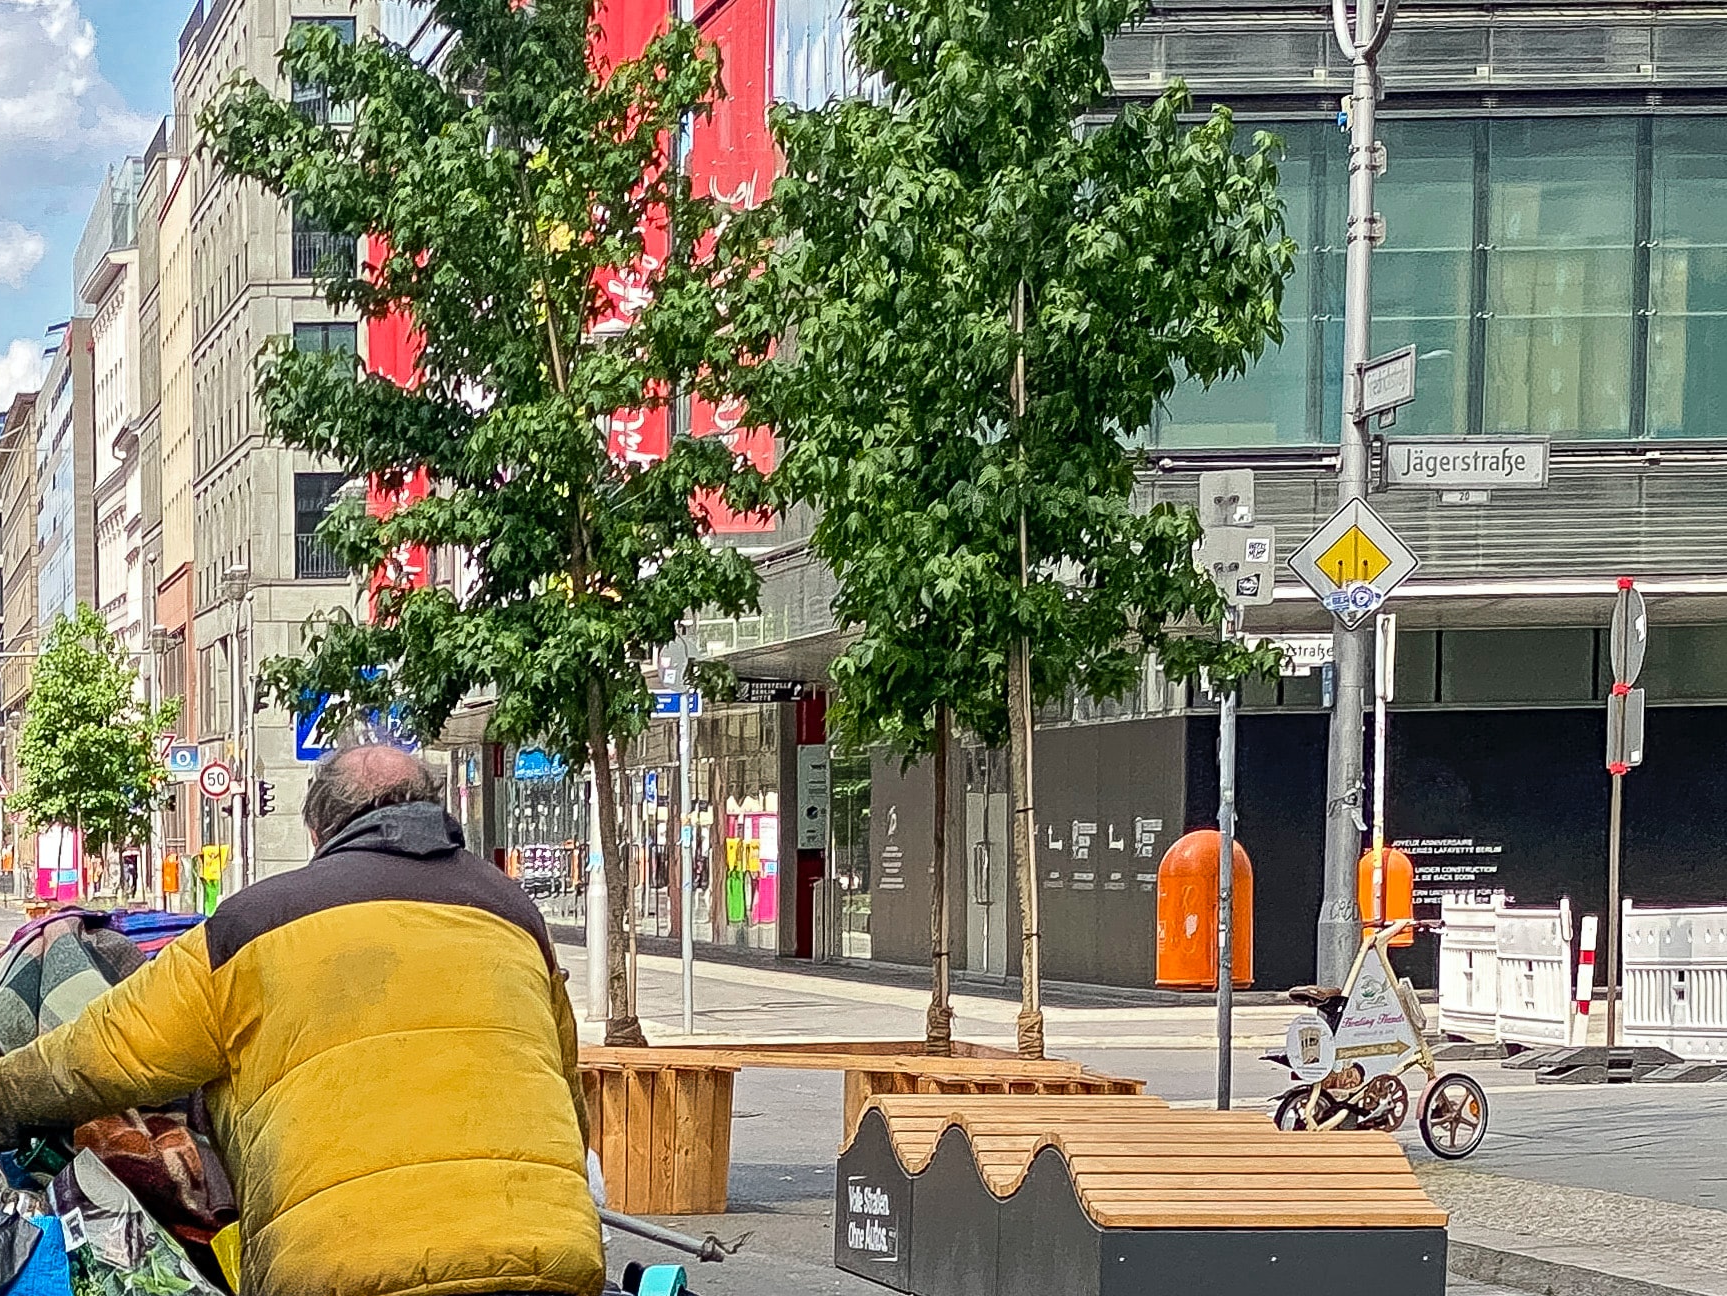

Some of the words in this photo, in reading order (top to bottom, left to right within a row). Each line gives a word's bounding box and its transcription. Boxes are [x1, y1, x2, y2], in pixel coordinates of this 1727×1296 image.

[1400, 447, 1526, 478] Jägerstraße
[1458, 492, 1471, 501] 20
[207, 772, 225, 787] 50
[1391, 839, 1420, 847] JOYEUX
[1421, 838, 1473, 847] ANNIVERSAIRE
[1415, 866, 1441, 874] UNDER
